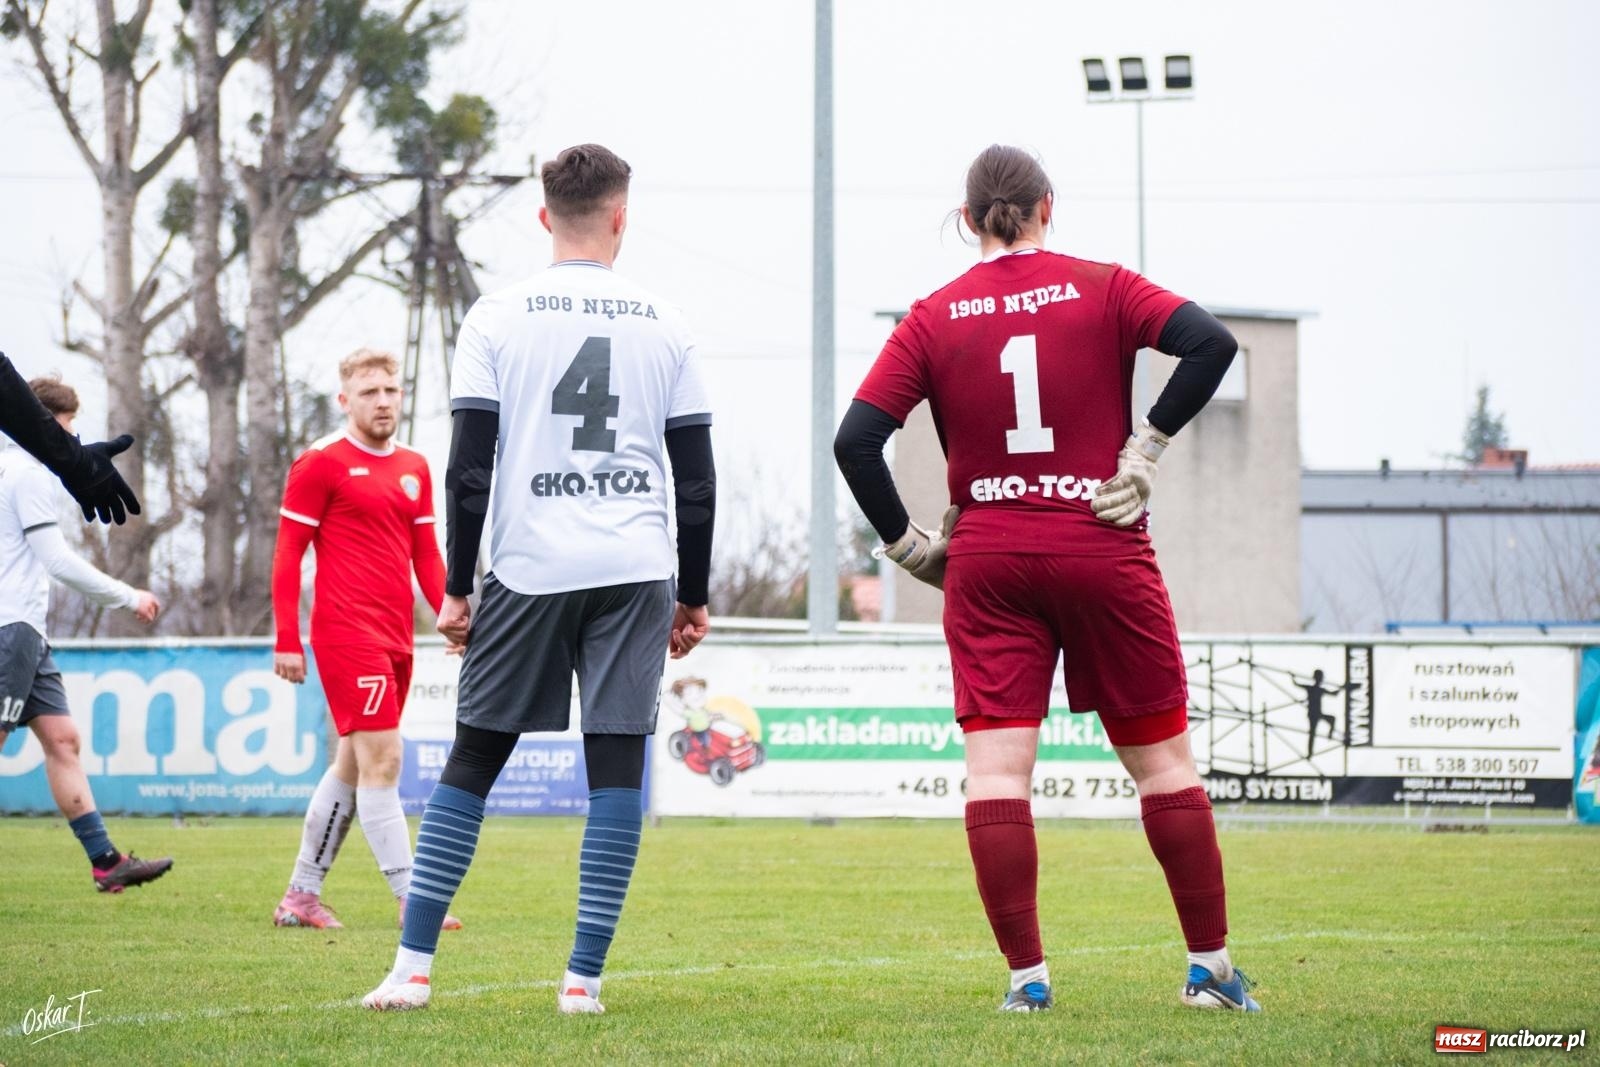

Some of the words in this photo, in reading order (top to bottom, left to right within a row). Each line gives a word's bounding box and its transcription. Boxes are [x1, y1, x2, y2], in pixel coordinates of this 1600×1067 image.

[526, 295, 573, 313] 1908
[582, 298, 659, 320] NĘDZA
[949, 296, 996, 320] 1908
[1003, 282, 1081, 314] NĘDZA
[551, 336, 620, 453] 4
[1000, 334, 1055, 455] 1
[530, 470, 652, 497] EKO-TOX
[1414, 660, 1515, 676] rusztowań
[356, 674, 388, 717] 7
[1349, 648, 1370, 746] WYNAJEM
[1409, 686, 1415, 701] i
[1420, 686, 1520, 702] szalunków
[1, 696, 25, 723] 10
[1409, 713, 1521, 733] stropowych
[1435, 757, 1467, 774] 538
[1471, 758, 1503, 774] 300
[1508, 758, 1540, 774] 507
[896, 777, 949, 798] +48
[1086, 777, 1137, 798] 735
[1245, 778, 1333, 801] SYSTEM
